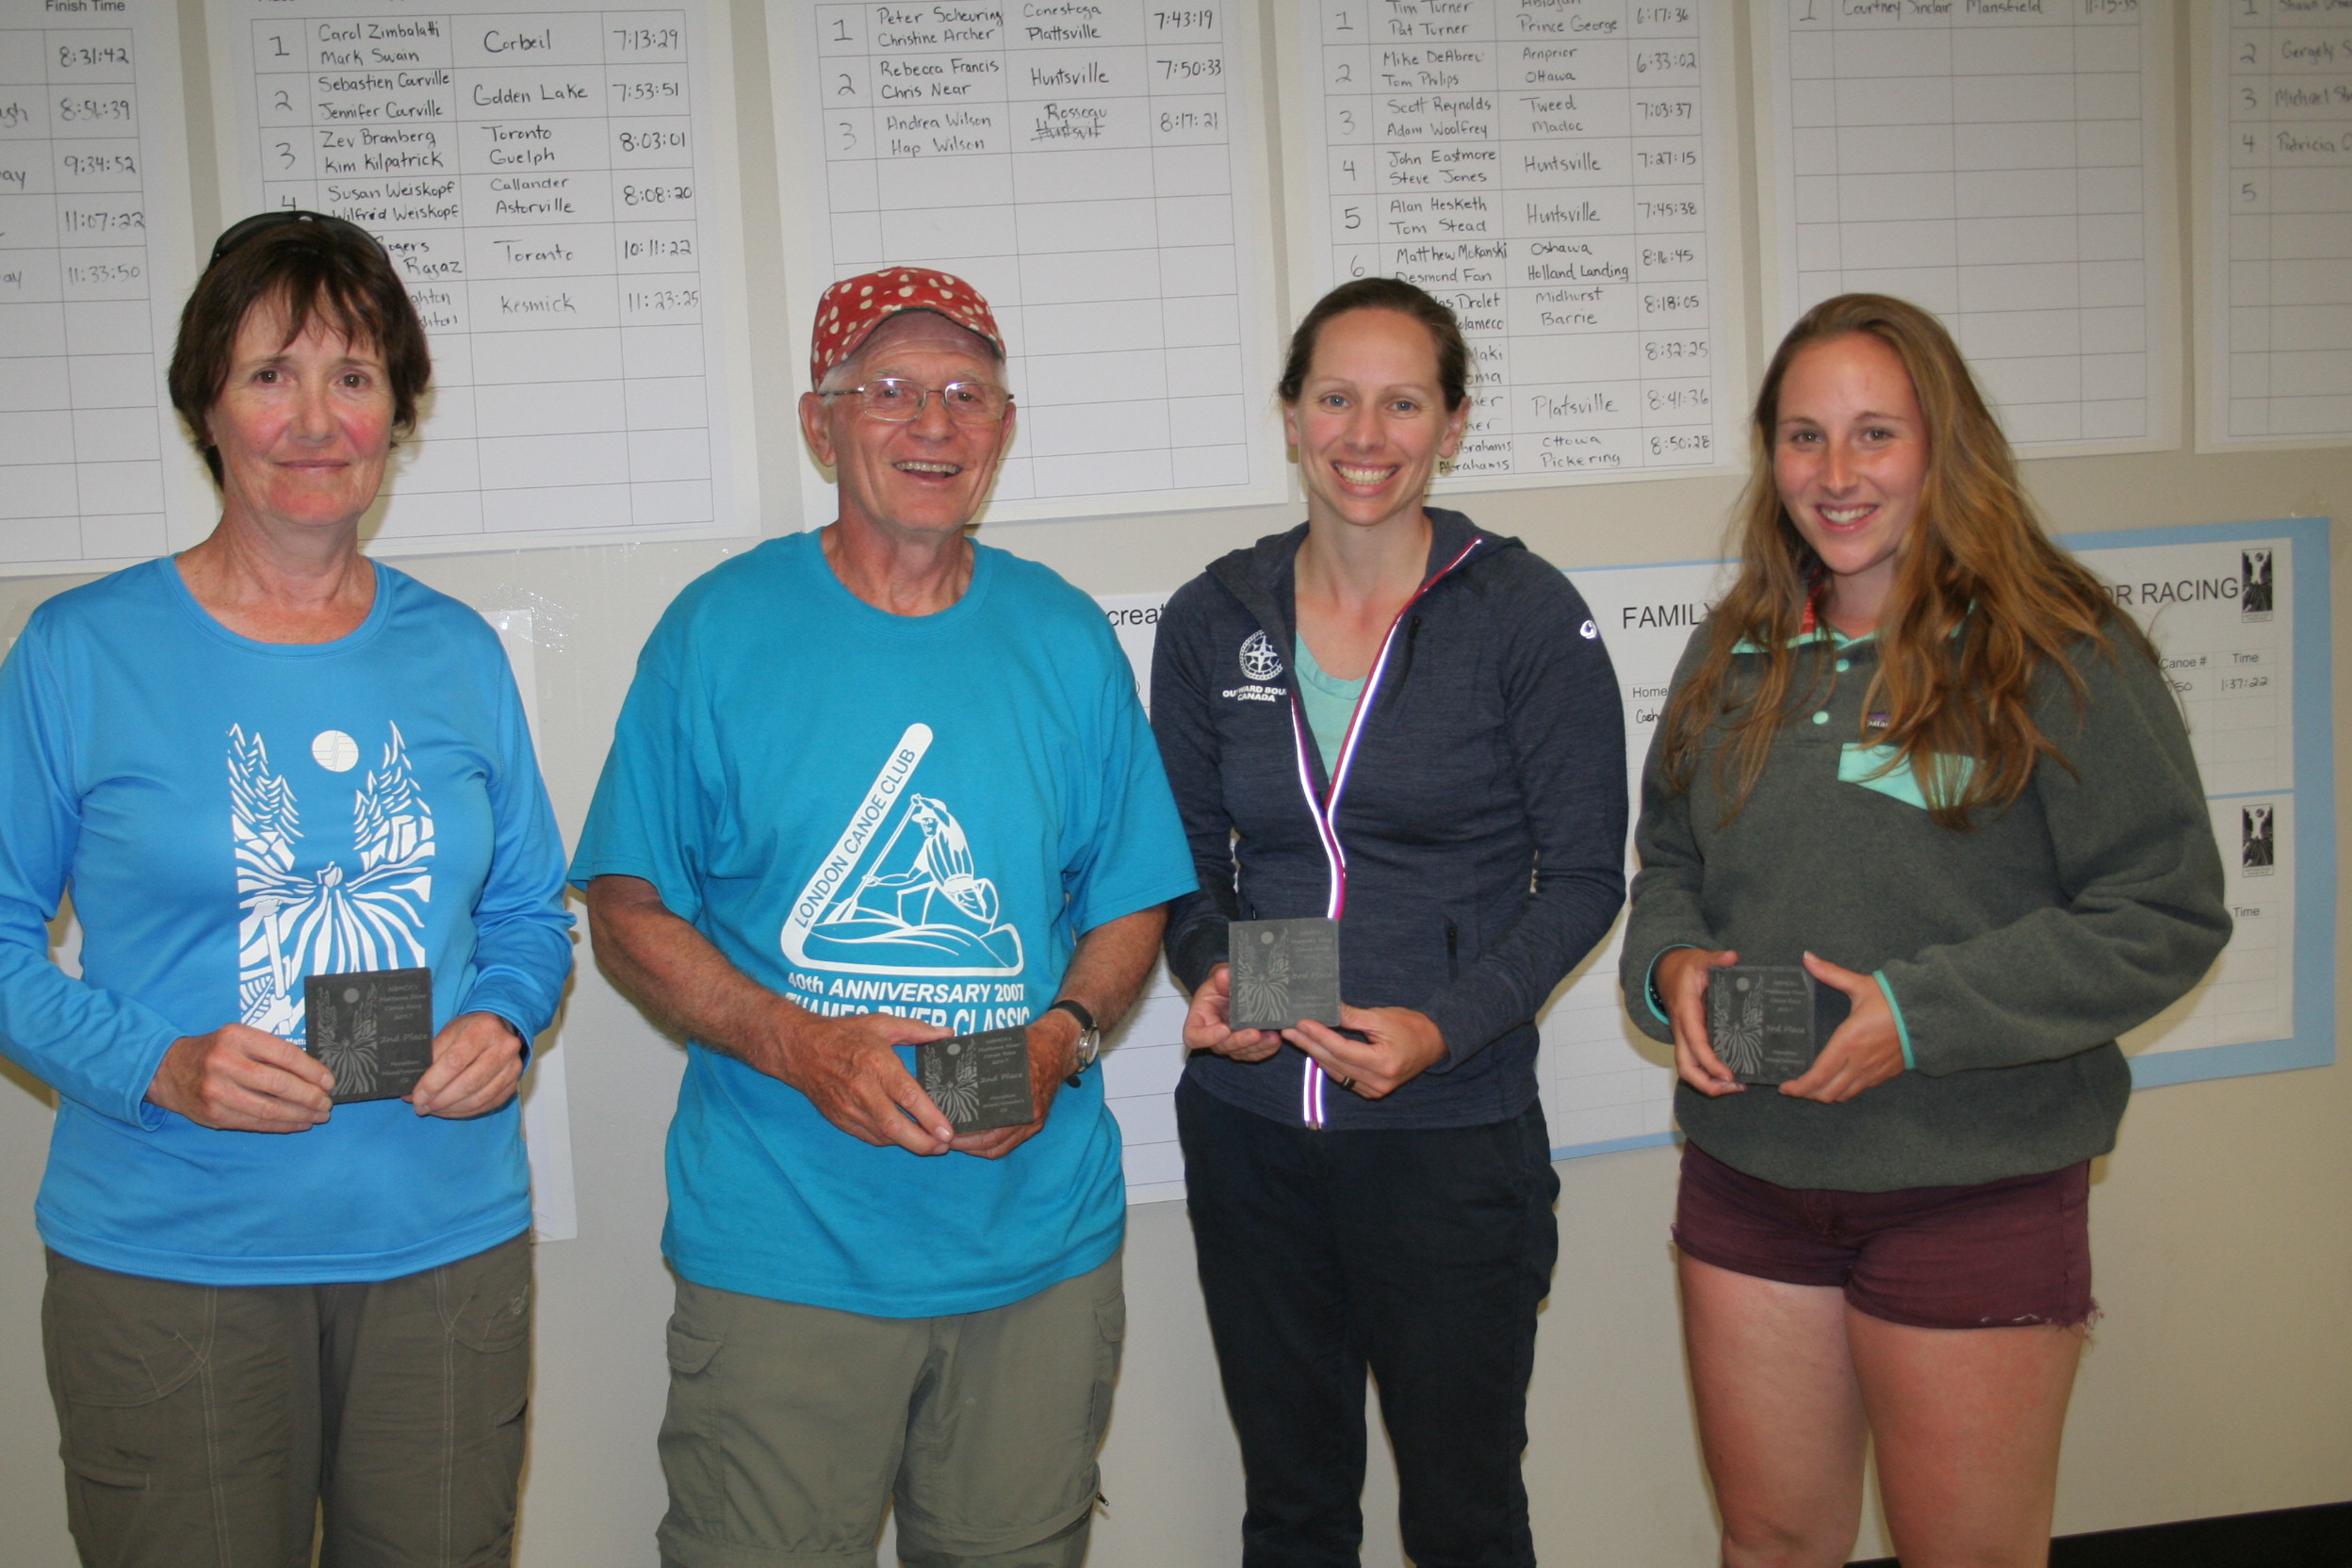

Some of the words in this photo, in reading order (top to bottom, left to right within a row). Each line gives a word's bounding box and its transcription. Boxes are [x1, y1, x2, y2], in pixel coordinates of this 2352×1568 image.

[45, 0, 87, 11] Finish
[94, 0, 126, 11] Time
[1385, 0, 1417, 14] Tim
[1421, 0, 1472, 14] Turner
[876, 8, 923, 24] Peter
[1153, 9, 1213, 30] 7:43:19
[1335, 11, 1353, 30] 1
[1516, 13, 1564, 32] Prince
[1571, 14, 1618, 34] George
[1637, 8, 1690, 24] 6:17:36
[318, 23, 361, 42] Carol
[833, 19, 854, 41] 1
[878, 32, 938, 47] Christine
[944, 27, 995, 41] Archer
[1025, 24, 1102, 41] Plattsville
[1388, 19, 1413, 36] Pat
[1418, 23, 1471, 36] Turner
[270, 36, 290, 57] 1
[612, 29, 678, 51] 7:13:29
[59, 46, 130, 67] 8:31:42
[320, 51, 364, 67] Mark
[371, 48, 419, 64] Swain
[1382, 51, 1420, 67] Mike
[1523, 46, 1577, 60] Arnprior
[2240, 43, 2256, 64] 2
[880, 60, 944, 77] Rebecca
[951, 57, 1000, 74] Francis
[1156, 58, 1221, 80] 7:50:33
[1636, 52, 1697, 74] 6:33:02
[318, 76, 393, 92] Sebastien
[398, 70, 450, 88] Carville
[1030, 62, 1110, 87] Huntsville
[1335, 64, 1351, 84] 2
[1381, 74, 1413, 88] Tom
[540, 84, 589, 102] Lake
[612, 82, 679, 103] 7:53:51
[838, 74, 857, 95] 2
[881, 84, 923, 100] Chris
[931, 82, 972, 97] Near
[274, 90, 293, 111] 2
[1387, 97, 1429, 114] Scott
[1431, 96, 1492, 117] Reynolds
[1519, 94, 1577, 113] Tweed
[2241, 88, 2256, 110] 3
[2275, 89, 2329, 108] Michael
[318, 102, 380, 121] Jennifer
[385, 99, 444, 119] Carville
[1636, 102, 1692, 121] 7:03:37
[887, 114, 940, 132] Andrea
[945, 111, 991, 128] Wilson
[1160, 111, 1217, 133] 8:17:21
[1339, 109, 1356, 136] 3
[1387, 122, 1423, 137] Adam
[1430, 121, 1488, 139] Woolfrey
[1531, 121, 1584, 133] Madoc
[319, 130, 355, 148] Zev
[481, 124, 552, 142] Toronto
[619, 132, 686, 153] 8:03:01
[839, 122, 857, 151] 3
[2277, 131, 2335, 153] Patricia
[891, 139, 922, 157] Hap
[933, 136, 986, 154] Wilson
[2243, 134, 2255, 154] 4
[64, 155, 137, 175] 9:34:52
[275, 142, 296, 171] 3
[324, 156, 356, 173] Kim
[364, 151, 444, 172] Kilpatrick
[489, 147, 555, 166] Guelph
[1387, 151, 1422, 168] John
[1431, 149, 1496, 163] Eastmore
[1525, 152, 1601, 172] Huntsville
[1637, 151, 1696, 168] 7:27:15
[1342, 160, 1356, 182] 4
[1389, 170, 1430, 186] Steve
[1439, 169, 1487, 184] Jones
[328, 187, 381, 203] Susan
[385, 182, 455, 200] Weiskopf
[490, 178, 570, 192] Callander
[2241, 183, 2256, 203] 5
[282, 195, 297, 211] 4
[623, 186, 693, 205] 8:08:20
[1390, 199, 1423, 214] Alan
[1430, 196, 1488, 212] Hesketh
[393, 204, 459, 221] Weiskopf
[496, 198, 576, 215] Astorville
[1527, 202, 1601, 225] Huntsville
[1637, 202, 1697, 219] 7:45:38
[65, 211, 145, 232] 11:07:22
[1344, 206, 1361, 229] 5
[1388, 220, 1427, 236] Tom
[1439, 219, 1487, 233] Stead
[493, 239, 573, 263] Toronto
[624, 239, 692, 259] 10:11:22
[1396, 246, 1456, 265] Matthew
[1531, 241, 1592, 255] Oshawa
[1642, 249, 1693, 266] 8:16:45
[68, 266, 140, 283] 11:33:50
[1350, 254, 1365, 277] 6
[1527, 263, 1576, 281] Holland
[1580, 262, 1629, 283] Landing
[1395, 267, 1458, 284] Desmond
[1462, 269, 1492, 282] Fan
[629, 290, 699, 313] 11:23:25
[1536, 286, 1604, 303] Midhurst
[1644, 295, 1699, 313] 8:18:05
[1541, 310, 1598, 327] Barrie
[1645, 341, 1708, 360] 8:32:25
[1531, 393, 1619, 418] Platsville
[1648, 389, 1708, 410] 8:41:36
[1651, 435, 1709, 455] 8:50:28
[1540, 452, 1620, 469] Pickering
[2141, 577, 2239, 605] RACING
[2160, 656, 2197, 670] Canoe
[2232, 652, 2259, 664] Time
[1632, 686, 1668, 699] Home
[2221, 677, 2268, 692] 1:37:22
[1237, 693, 1276, 702] CANADA
[794, 855, 848, 928] LONDON
[843, 793, 887, 855] CANOE
[880, 748, 916, 795] CLUB
[2232, 906, 2261, 918] Time
[788, 972, 824, 995] 40th
[828, 978, 991, 1004] ANNIVERSARY
[995, 983, 1024, 1002] 2007
